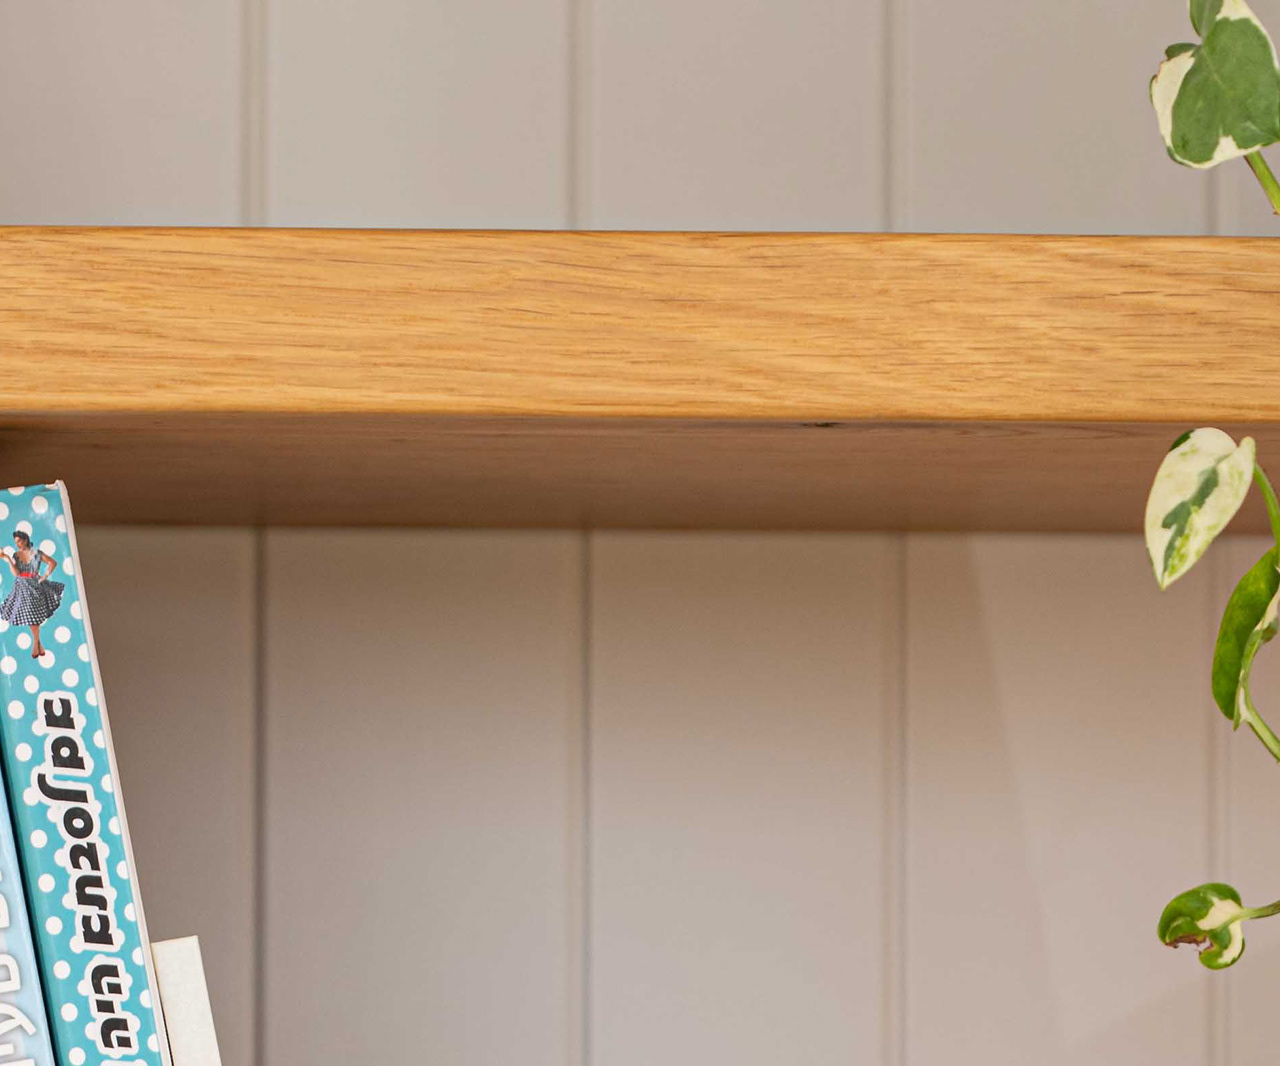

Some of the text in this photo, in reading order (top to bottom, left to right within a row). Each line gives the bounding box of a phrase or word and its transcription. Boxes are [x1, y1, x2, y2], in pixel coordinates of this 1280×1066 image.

[43, 697, 85, 770] אם
[38, 773, 113, 945] לסבתא
[90, 964, 131, 1049] היה
